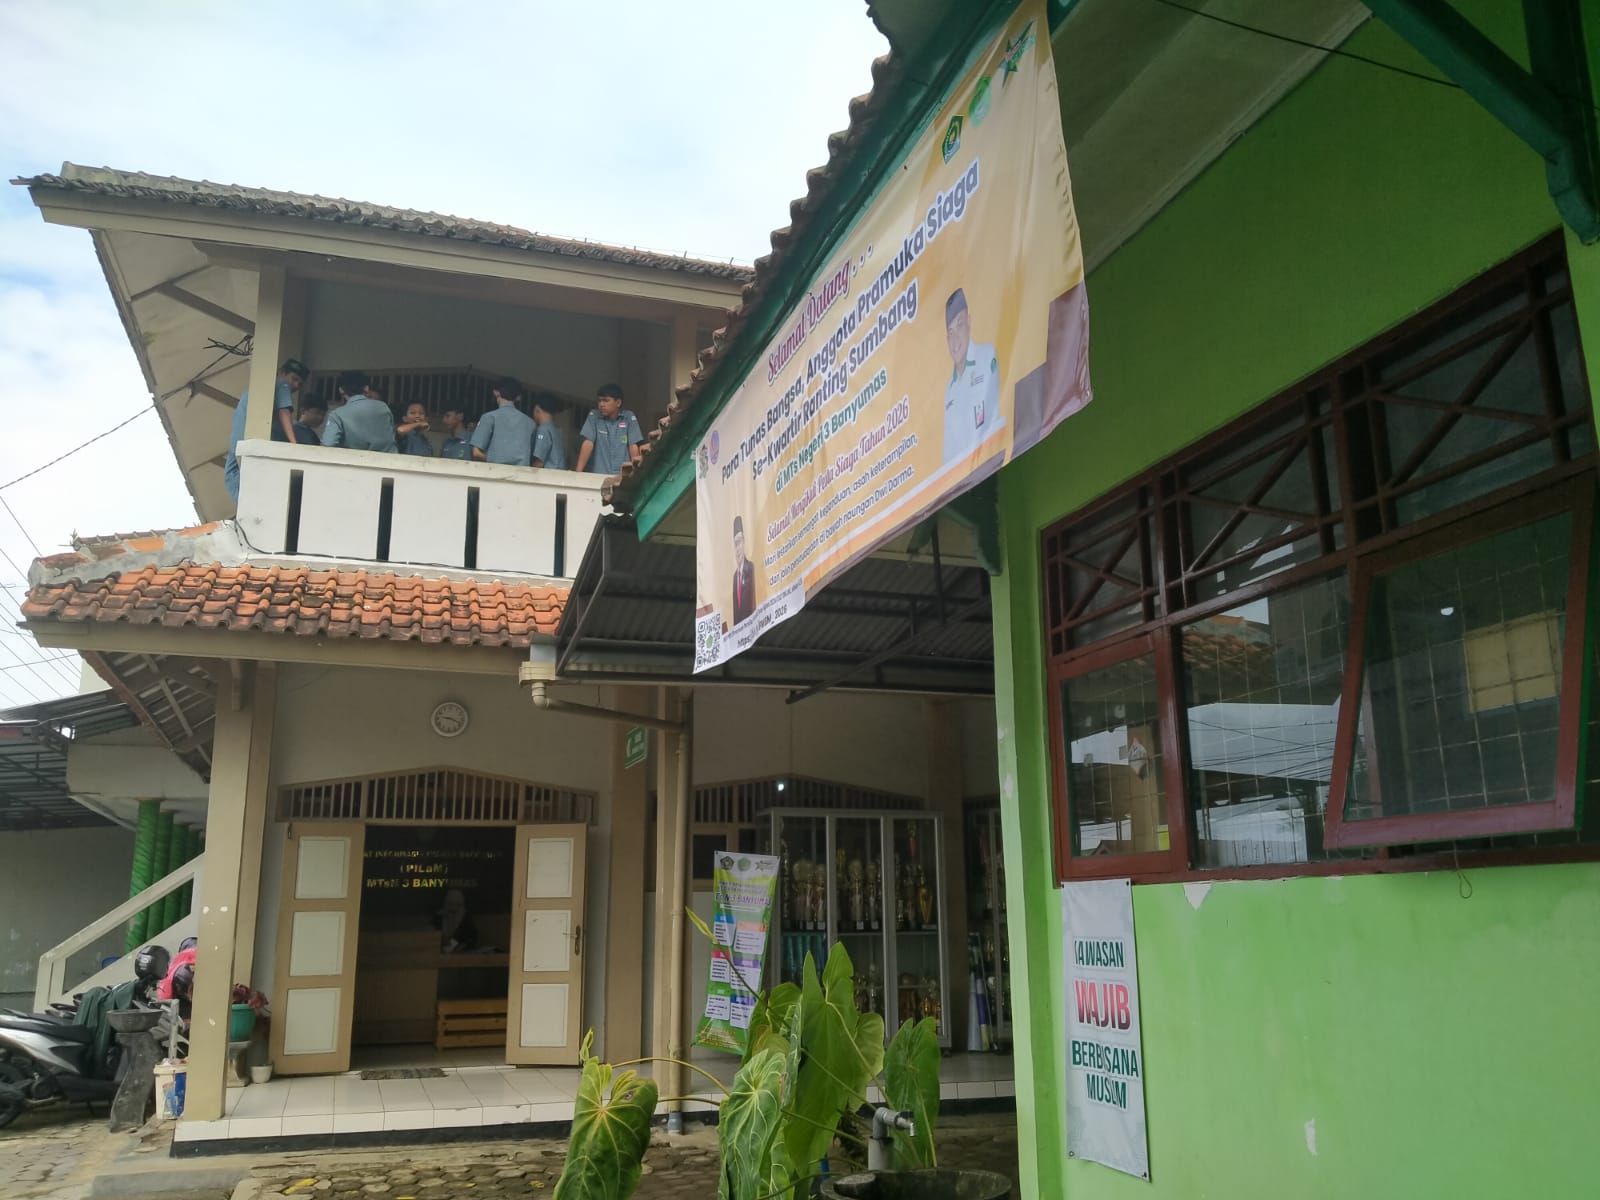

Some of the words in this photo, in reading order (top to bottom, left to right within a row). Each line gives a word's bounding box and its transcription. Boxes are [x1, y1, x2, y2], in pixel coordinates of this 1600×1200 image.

[722, 453, 739, 485] Para
[740, 422, 766, 462] Tunas
[767, 375, 804, 432] Bangsa,
[807, 310, 856, 384] Anggota
[858, 226, 924, 323] Pramuka
[926, 160, 979, 239] Siaga
[768, 312, 806, 383] Selamat
[807, 260, 850, 328] Datang
[752, 411, 802, 480] Se-Kwartir
[803, 362, 848, 425] Ranting
[849, 282, 917, 373] Sumbang
[776, 470, 783, 492] di
[783, 460, 798, 486] MTs
[799, 425, 823, 469] Negeri
[823, 421, 830, 439] 3
[831, 370, 887, 434] Banyumas
[834, 448, 859, 477] Siaga
[859, 425, 886, 457] Tahun
[886, 398, 909, 434] 2026
[853, 471, 870, 491] asah
[870, 434, 918, 477] keterampilan,
[843, 496, 874, 521] naungan
[1071, 1040, 1139, 1078] BERBSANA
